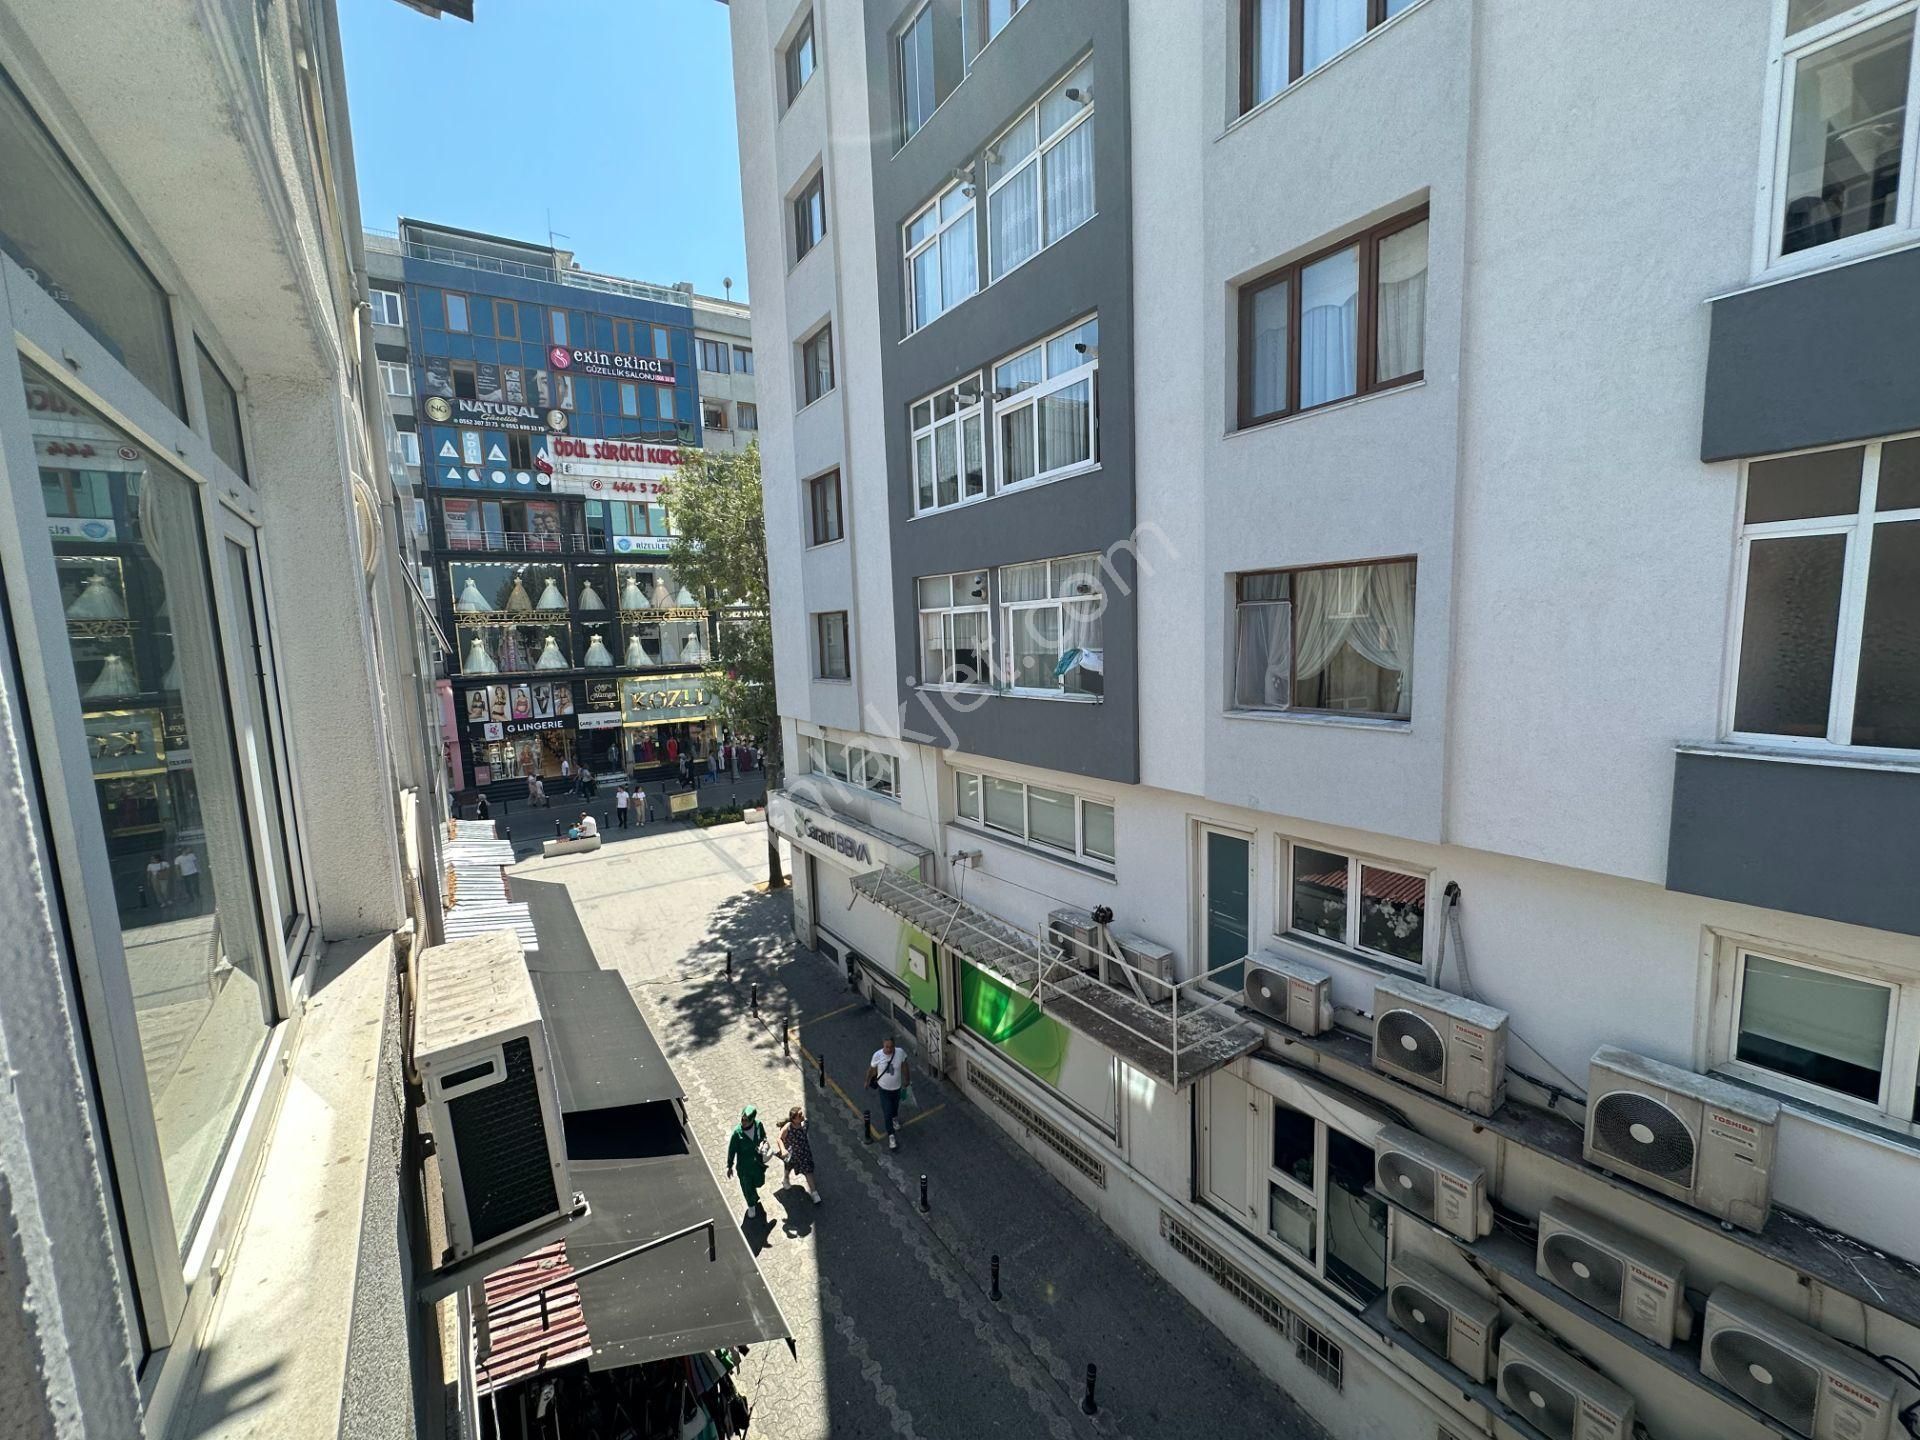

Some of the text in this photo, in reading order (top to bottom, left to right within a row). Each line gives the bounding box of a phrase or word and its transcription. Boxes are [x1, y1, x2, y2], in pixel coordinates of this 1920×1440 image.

[573, 350, 662, 373] ekin ekinci
[586, 365, 625, 377] GÜZELLİK
[625, 371, 655, 381] SALONU
[431, 404, 447, 413] NG
[459, 400, 539, 419] NATURAL
[553, 438, 590, 458] ÖDÜL
[593, 442, 645, 462] SÜRÜCÜ
[612, 481, 636, 493] 444
[640, 483, 647, 493] 5
[507, 720, 564, 733] G LINGERIE
[804, 819, 873, 866] Garanti BBVA
[1455, 1024, 1483, 1040] TOSHIBA
[1711, 1113, 1756, 1134] TOSHIBA
[1631, 1265, 1670, 1290] TOSHIBA
[1826, 1375, 1881, 1410] TOSHIBA
